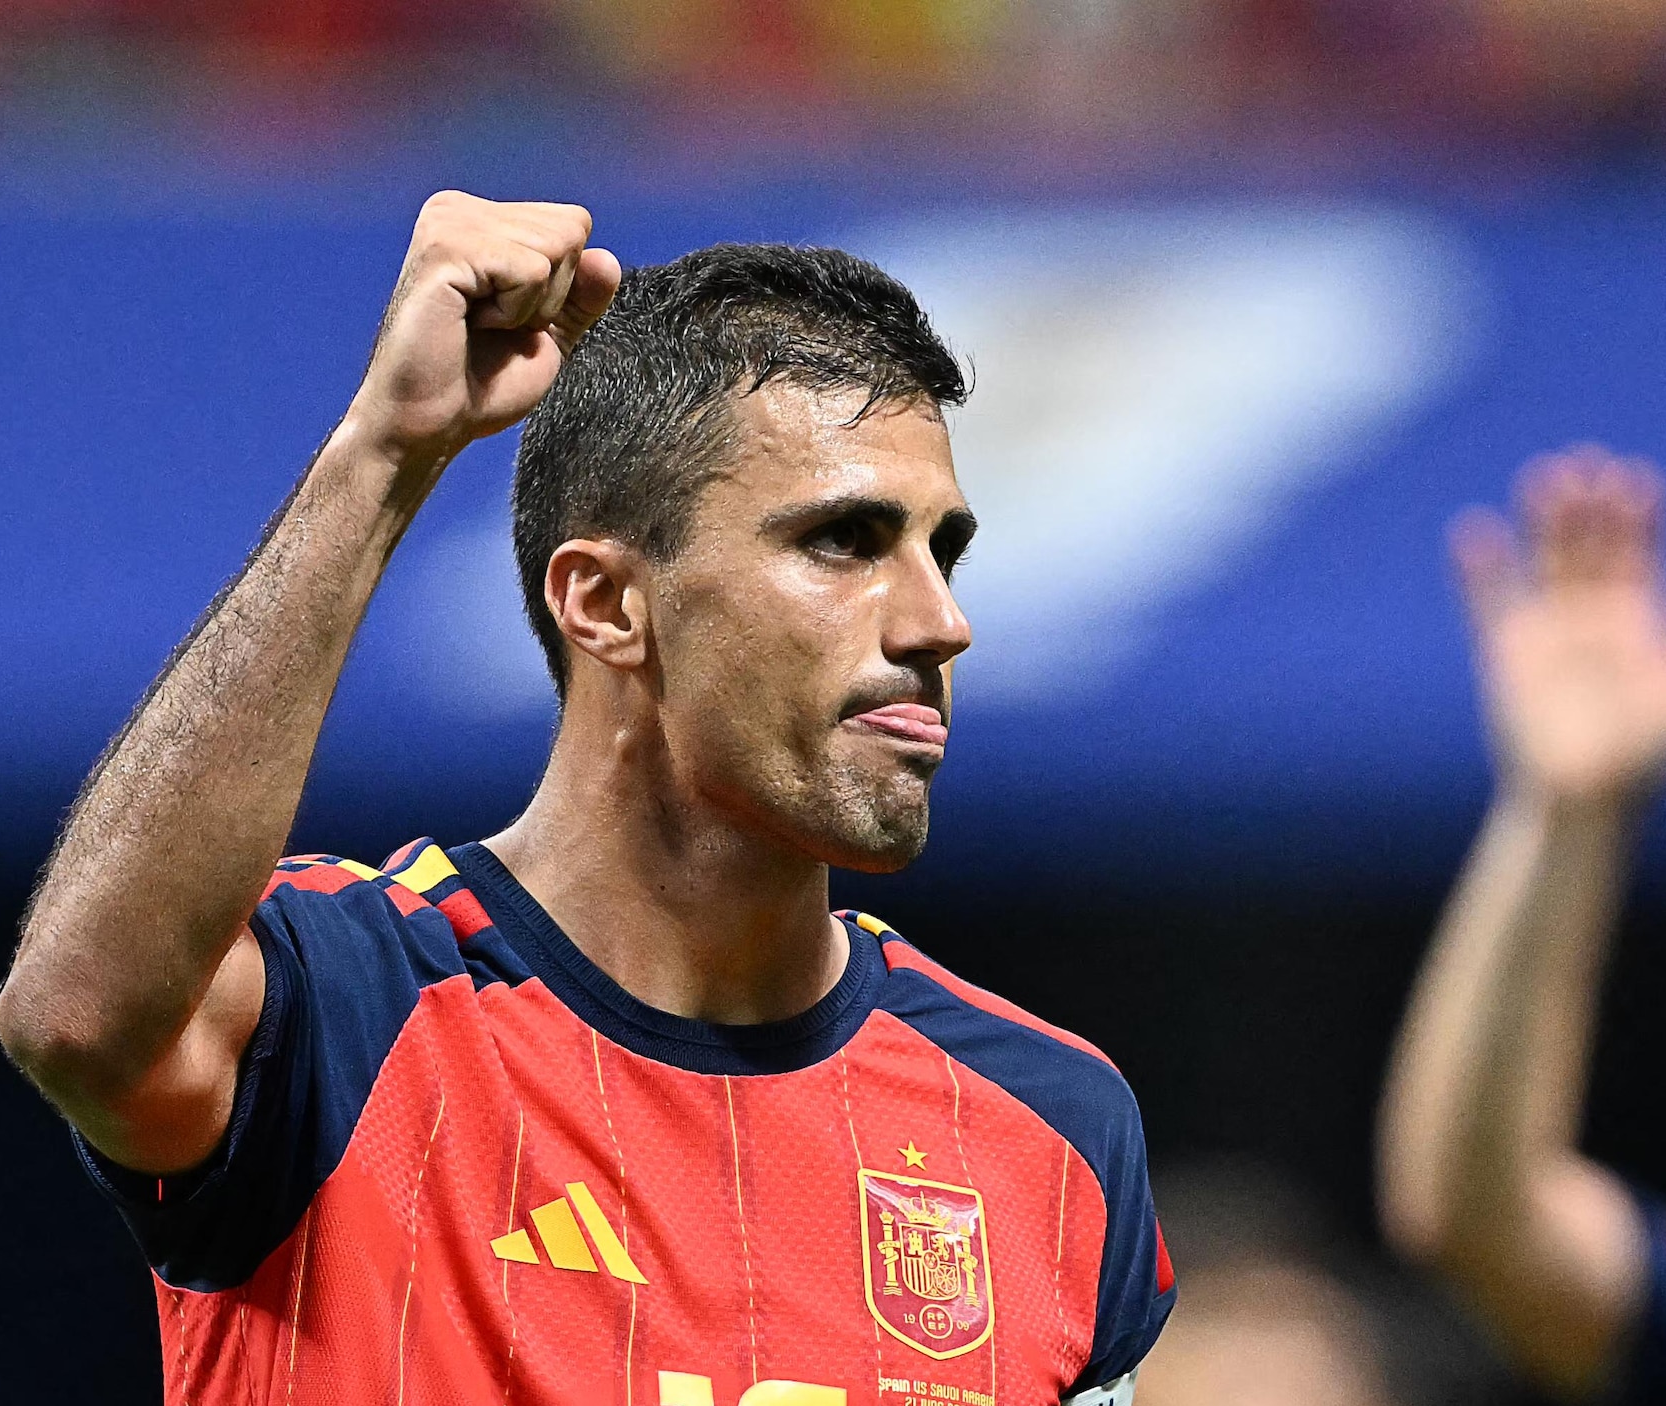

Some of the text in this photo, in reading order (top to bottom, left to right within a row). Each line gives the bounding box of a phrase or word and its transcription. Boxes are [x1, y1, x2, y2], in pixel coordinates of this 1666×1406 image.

[903, 1313, 916, 1324] 19
[878, 1378, 910, 1393] SPAIN
[930, 1383, 959, 1401] SAUDI
